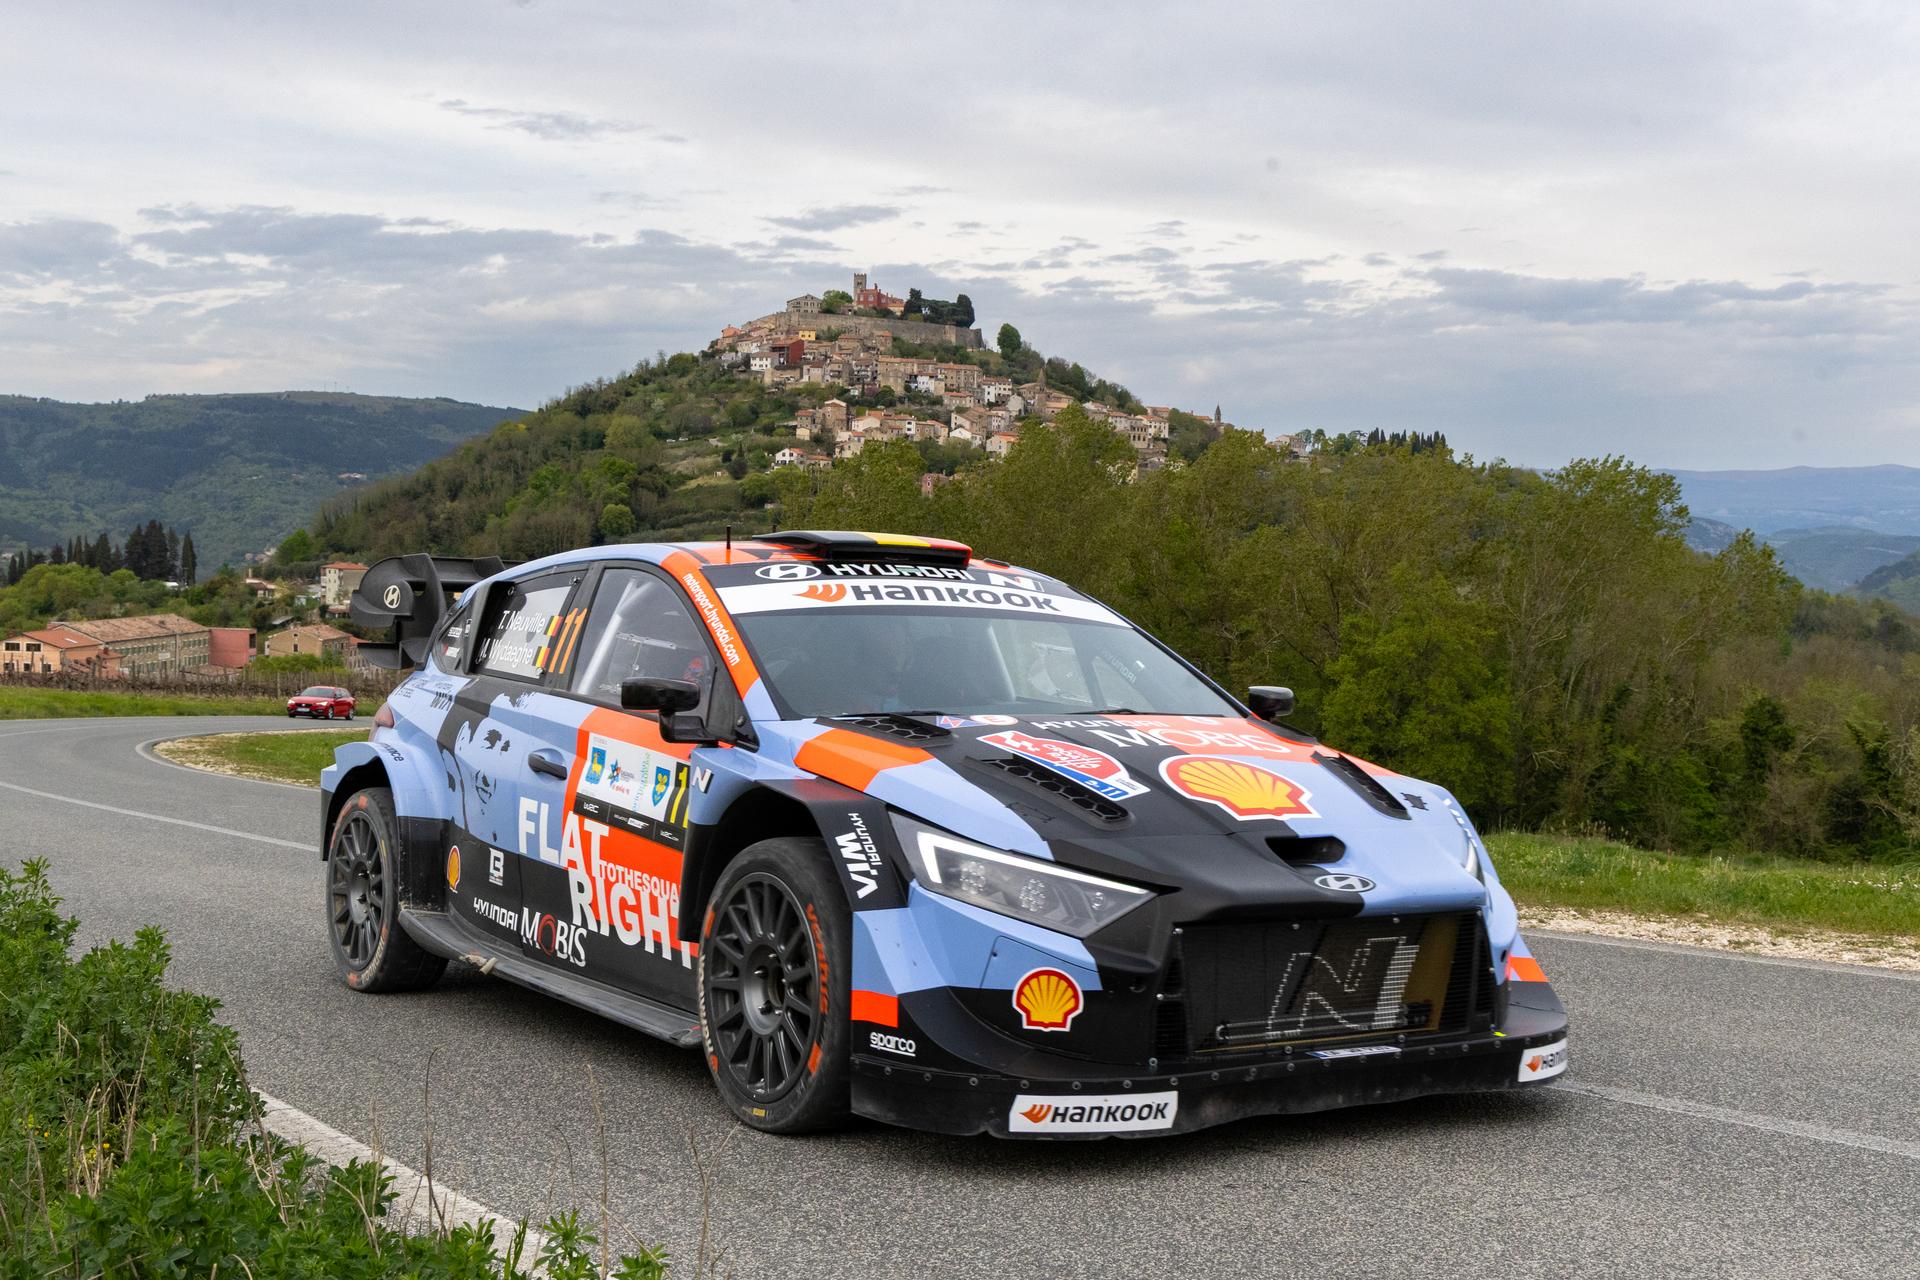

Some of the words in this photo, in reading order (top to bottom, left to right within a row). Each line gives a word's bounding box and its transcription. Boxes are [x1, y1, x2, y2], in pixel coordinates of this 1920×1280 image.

[827, 563, 977, 582] HYUNDAI
[497, 609, 511, 631] T.
[506, 610, 546, 633] Neuville
[682, 573, 741, 666] motorsport.hyundai.com
[548, 607, 588, 675] 11
[1030, 718, 1171, 731] HYUNDAI
[1087, 728, 1292, 754] MOBIS
[518, 796, 610, 878] FLAT
[847, 812, 883, 866] HYUNDAI
[600, 860, 681, 904] TOTHESQUA
[473, 897, 519, 932] HYUNDAI
[520, 906, 588, 968] MOBIS
[869, 1031, 916, 1054] sparco
